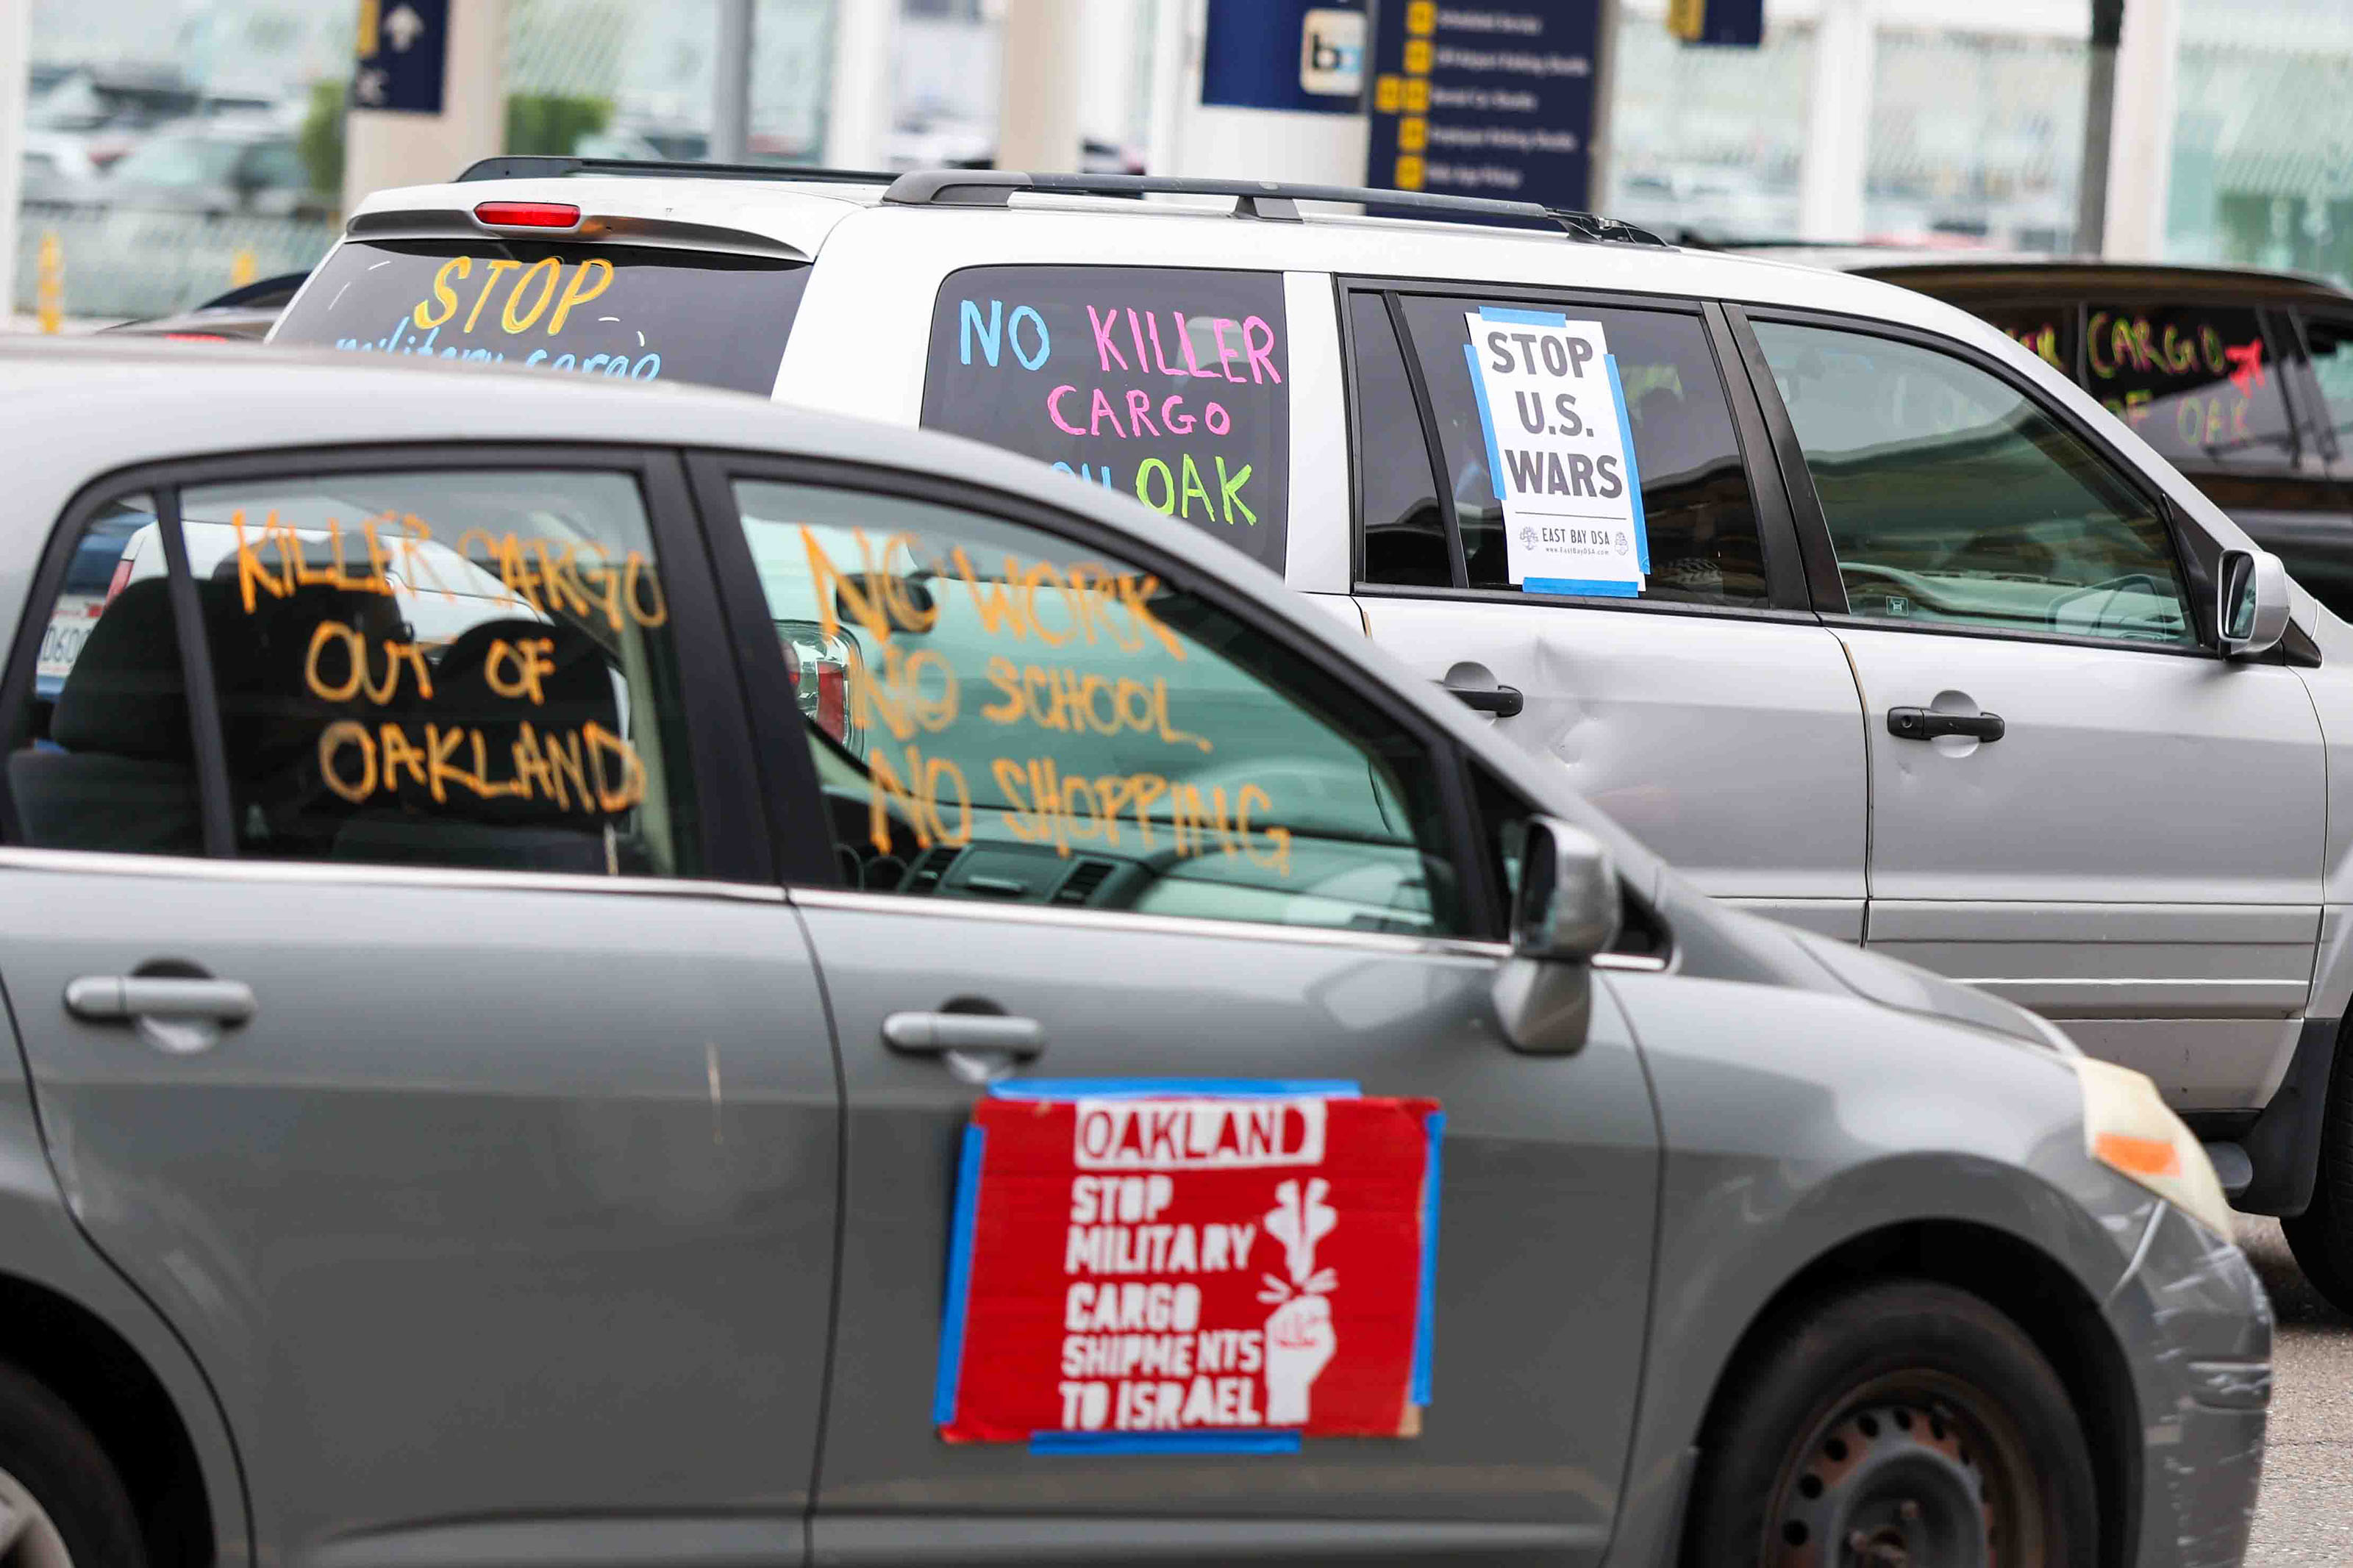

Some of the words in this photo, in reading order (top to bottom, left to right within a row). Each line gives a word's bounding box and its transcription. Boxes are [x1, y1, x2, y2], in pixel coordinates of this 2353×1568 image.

[414, 256, 615, 336] STOP
[960, 300, 1050, 370] NO
[1087, 305, 1282, 384] KILLER
[1487, 331, 1593, 379] STOP
[2087, 312, 2227, 379] CARGO
[1046, 384, 1230, 438] CARGO
[1515, 391, 1594, 437] U.S.
[1135, 454, 1257, 526] OAK
[1504, 449, 1624, 500] WARS
[1542, 527, 1565, 543] EAST
[1571, 529, 1587, 544] BAY
[1591, 531, 1610, 545] DSA
[232, 509, 454, 615] KILLER
[456, 526, 668, 633] CARGO
[798, 522, 949, 645] NO
[951, 545, 1188, 662] WORK
[304, 621, 456, 704] OUT
[485, 637, 556, 706] OF
[849, 643, 959, 740] NO
[982, 656, 1213, 753] SCHOOL
[318, 719, 647, 814] OAKLAND
[868, 745, 974, 854] NO
[991, 756, 1293, 878] SHOPPING
[1083, 1108, 1310, 1160] OAKLAND
[1071, 1175, 1173, 1225] STOP
[1063, 1223, 1255, 1275] MILITARY
[1065, 1282, 1202, 1333] CARGO
[1060, 1328, 1264, 1381] SHIPMENTS
[1059, 1381, 1109, 1431] TO
[1115, 1375, 1263, 1431] ISRAEL
